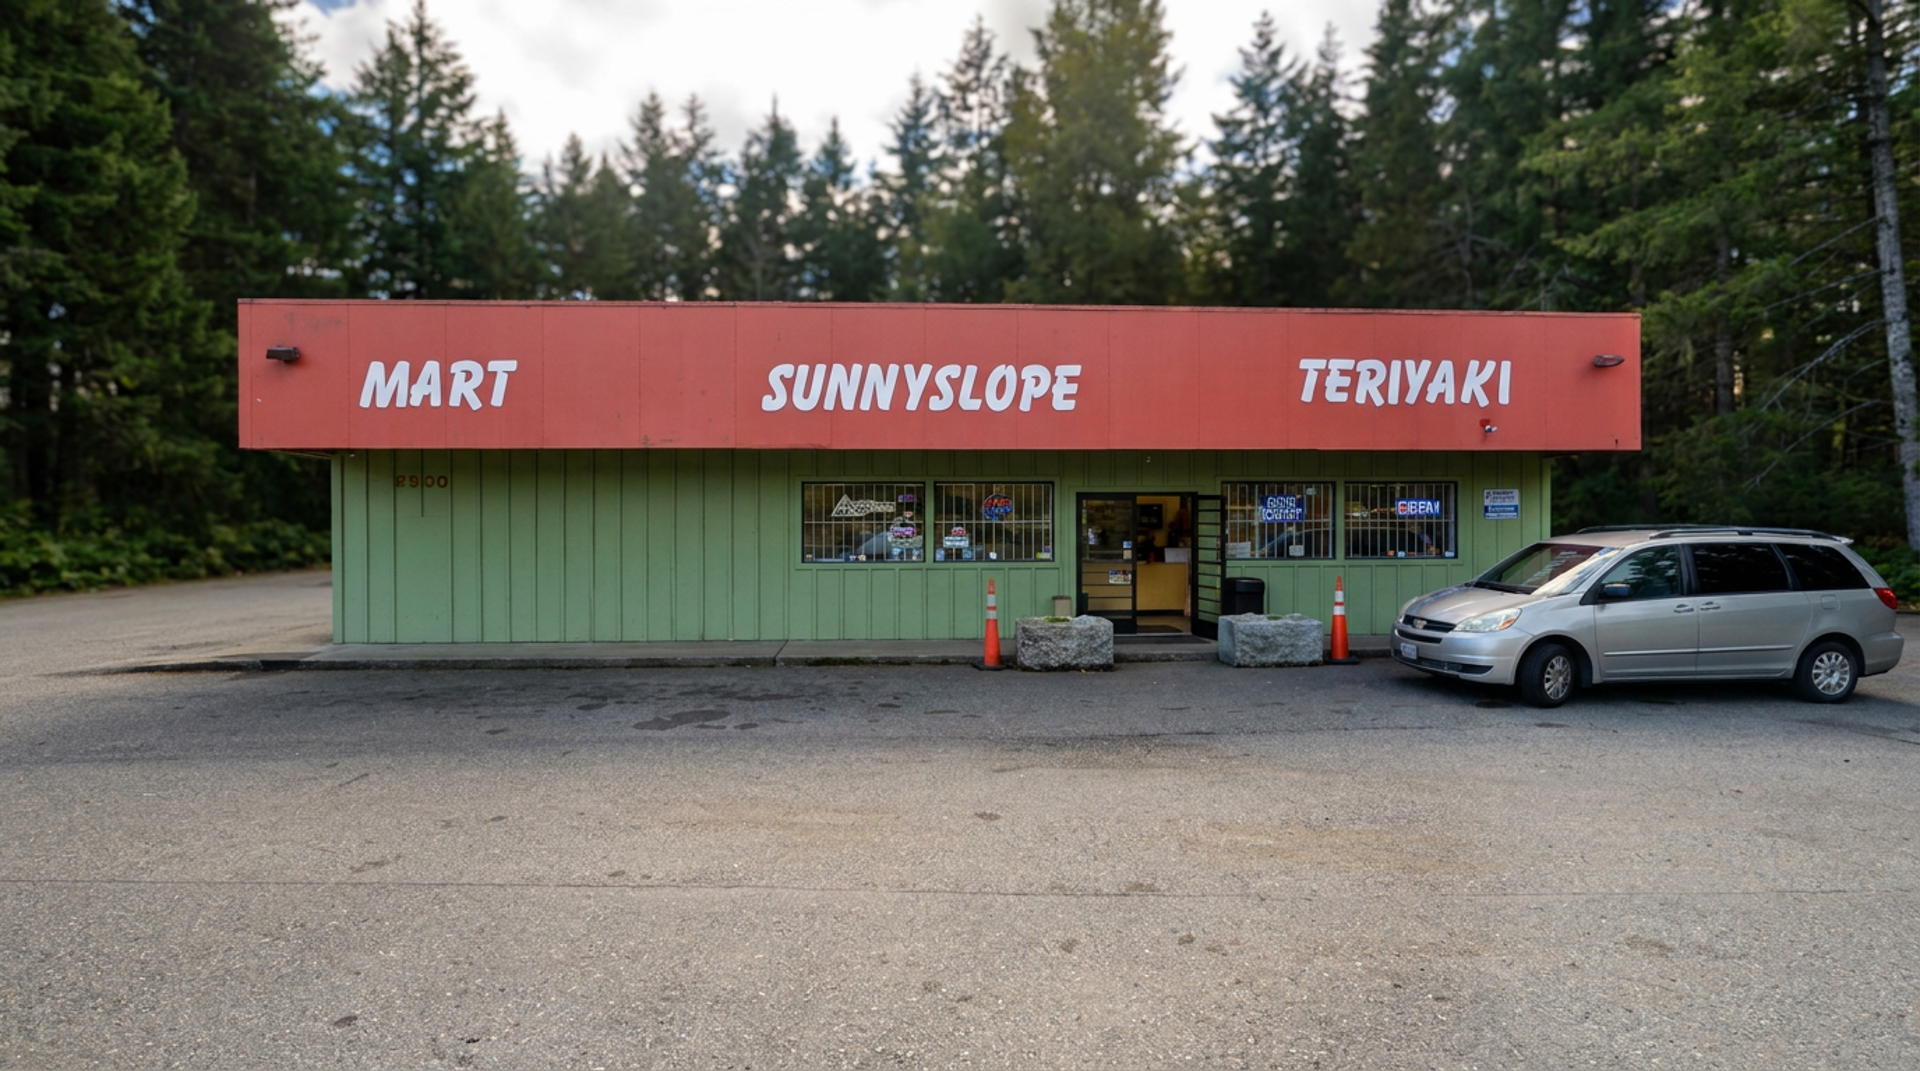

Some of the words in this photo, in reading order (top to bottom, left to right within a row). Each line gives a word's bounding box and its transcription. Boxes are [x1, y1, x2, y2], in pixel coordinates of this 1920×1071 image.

[359, 360, 518, 411] MART
[761, 363, 1083, 412] SUNNYSLOPE
[1298, 359, 1512, 407] TERIYAKI
